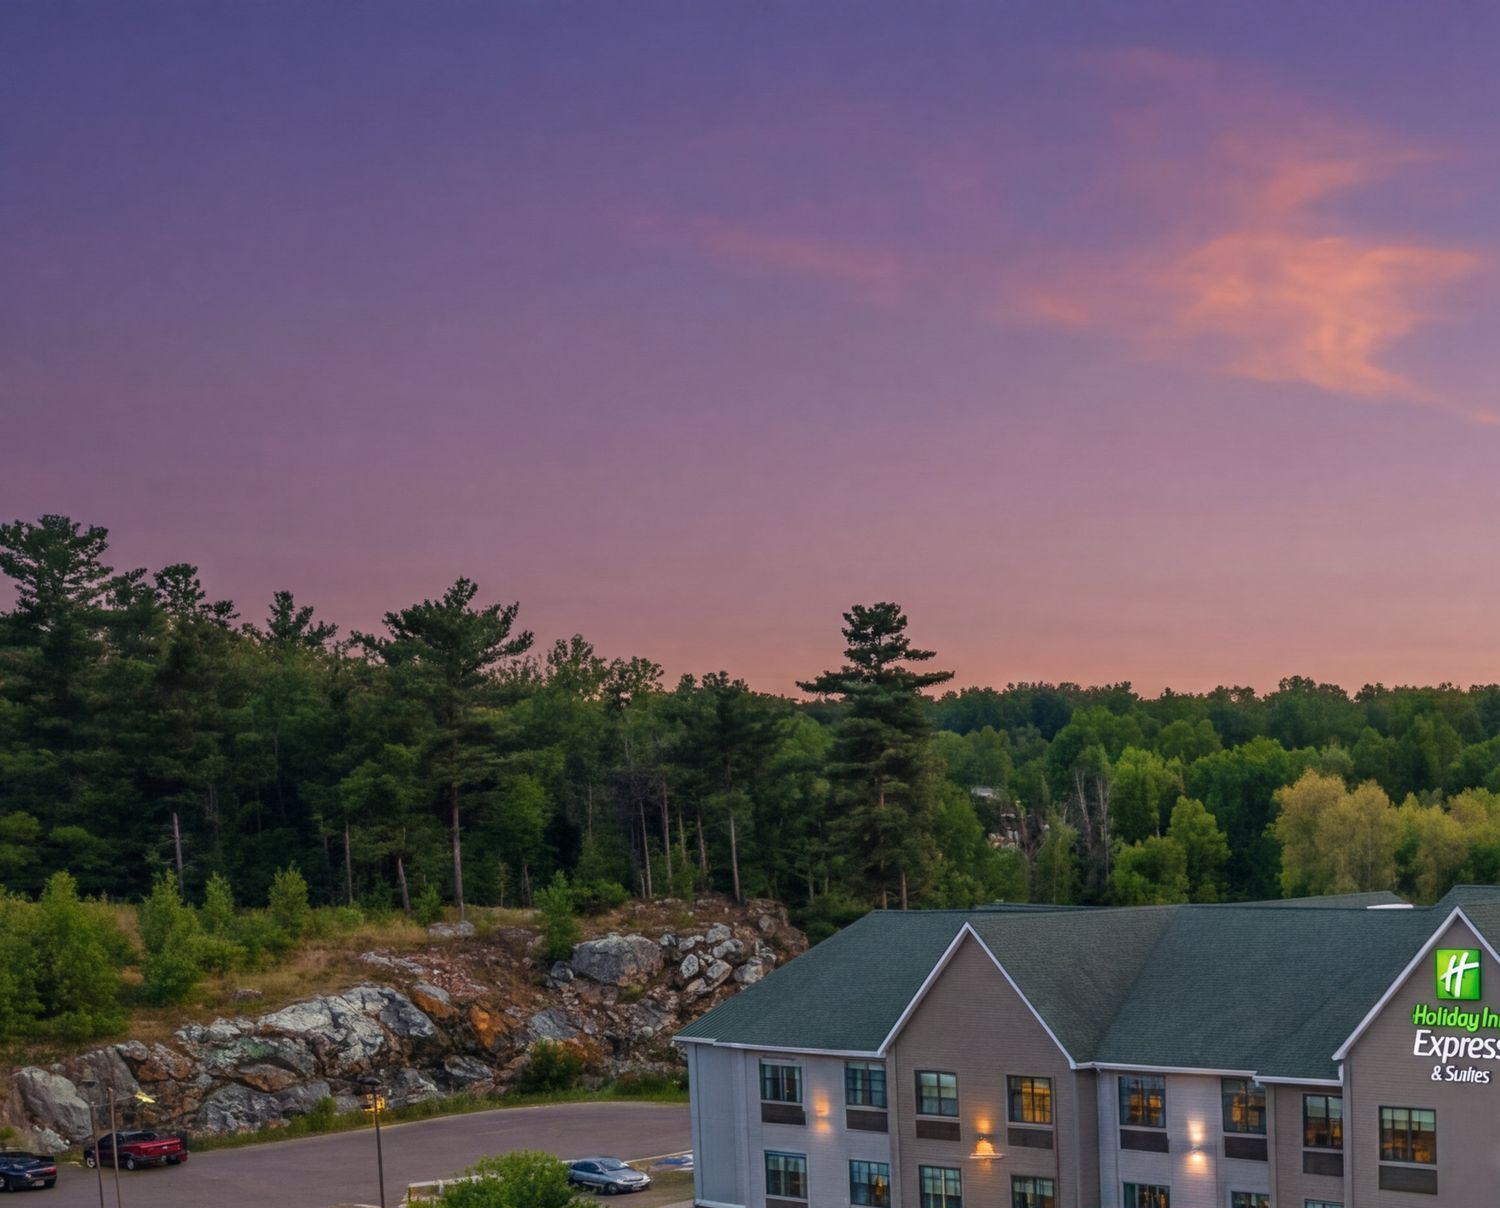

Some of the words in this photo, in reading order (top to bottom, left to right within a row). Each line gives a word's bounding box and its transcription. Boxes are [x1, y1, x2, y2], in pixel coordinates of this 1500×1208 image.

[1412, 1004, 1479, 1033] Holiday
[1431, 1065, 1442, 1081] &
[1444, 1065, 1491, 1083] Suites
